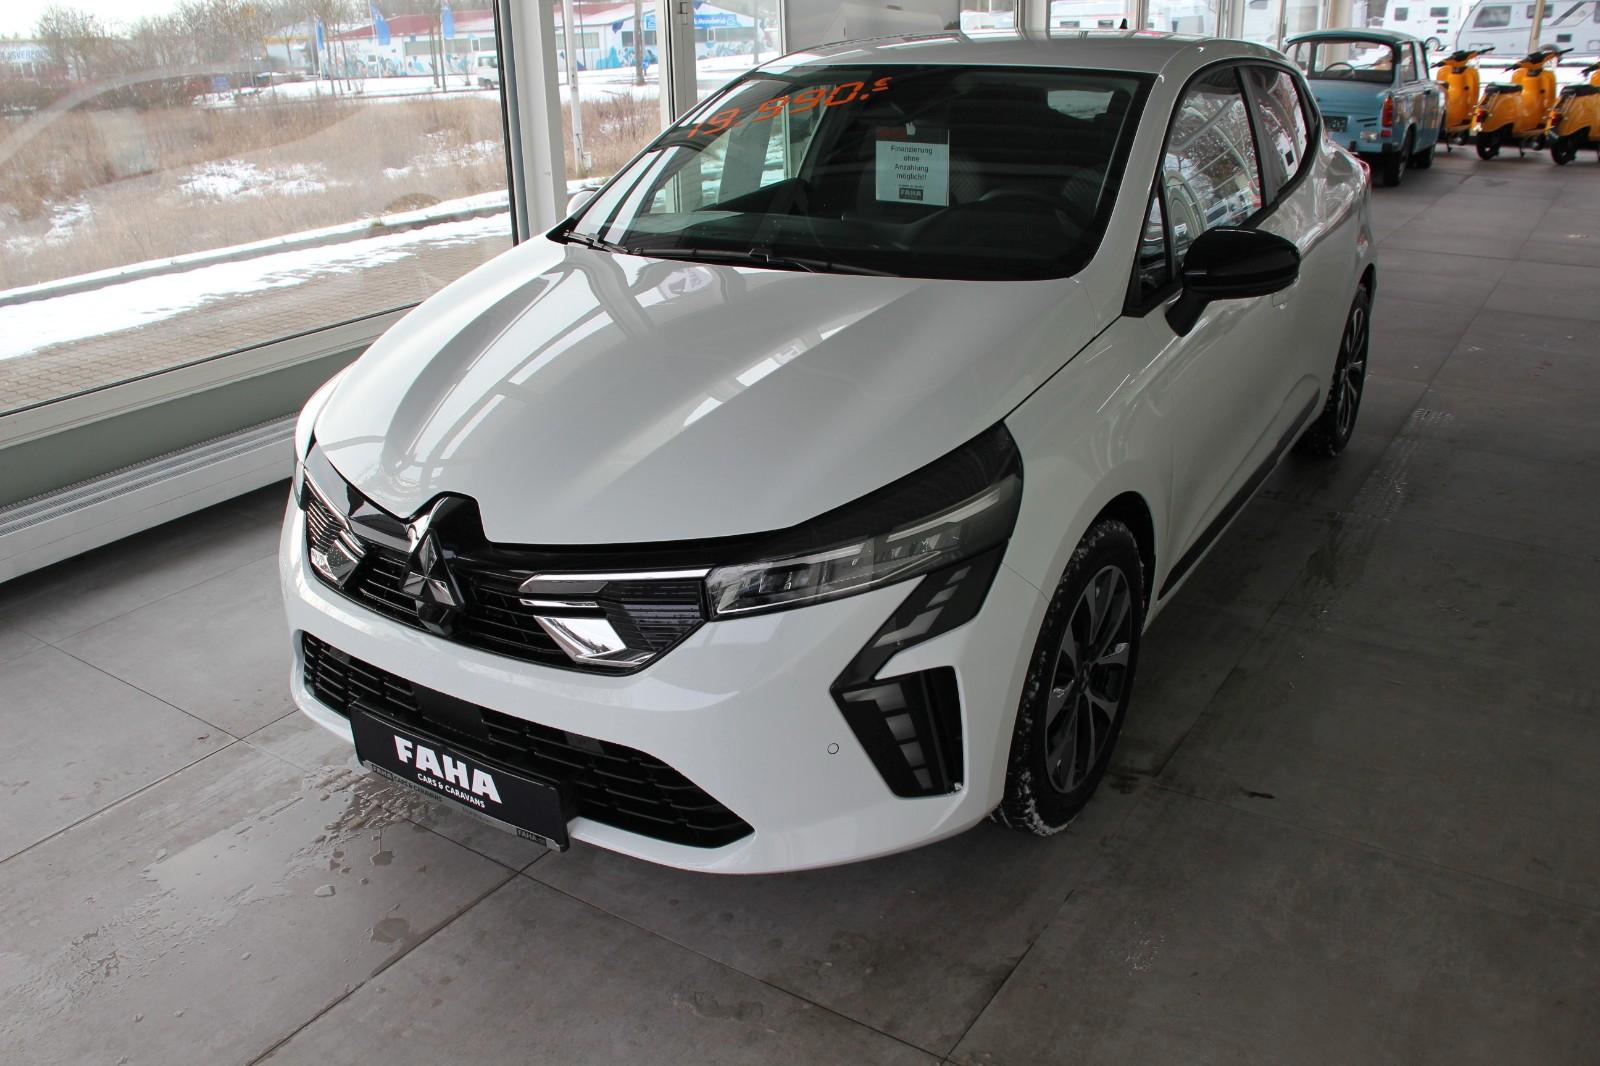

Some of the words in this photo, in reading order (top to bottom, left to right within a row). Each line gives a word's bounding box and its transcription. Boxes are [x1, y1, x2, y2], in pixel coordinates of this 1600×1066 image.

[890, 145, 933, 155] Finanzierung
[894, 163, 929, 173] Anzahlung
[394, 735, 502, 804] FAHA
[417, 773, 437, 788] CARS
[445, 784, 486, 809] CARAVANS
